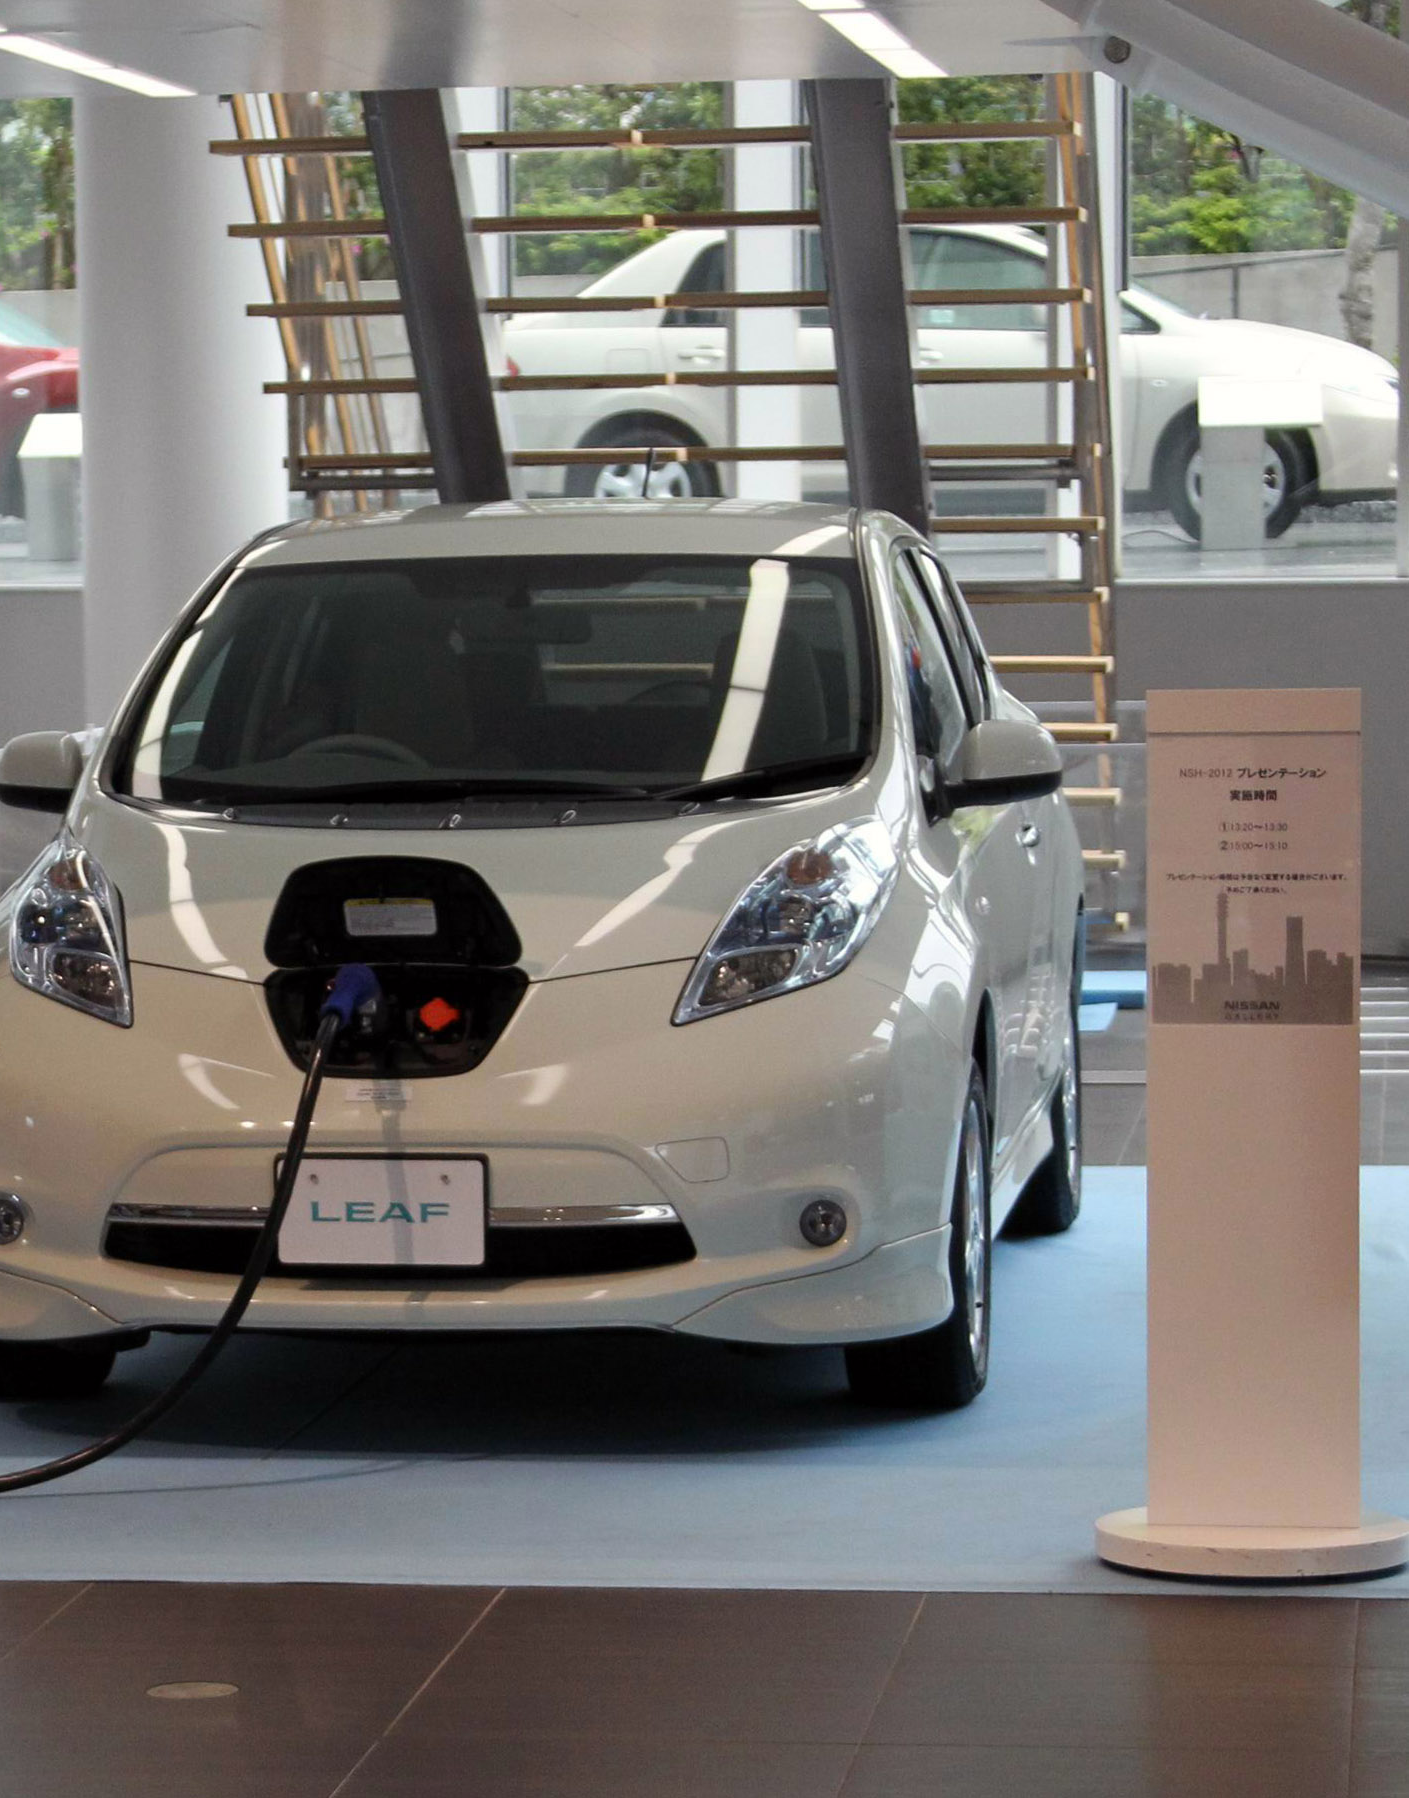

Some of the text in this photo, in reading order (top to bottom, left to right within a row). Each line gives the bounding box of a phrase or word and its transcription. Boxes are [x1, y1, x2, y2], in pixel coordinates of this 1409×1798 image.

[1237, 767, 1327, 779] プレゼンテーション
[1230, 790, 1278, 802] 実施時間
[1224, 1001, 1280, 1010] NISSAN
[310, 1201, 450, 1224] LEAF
